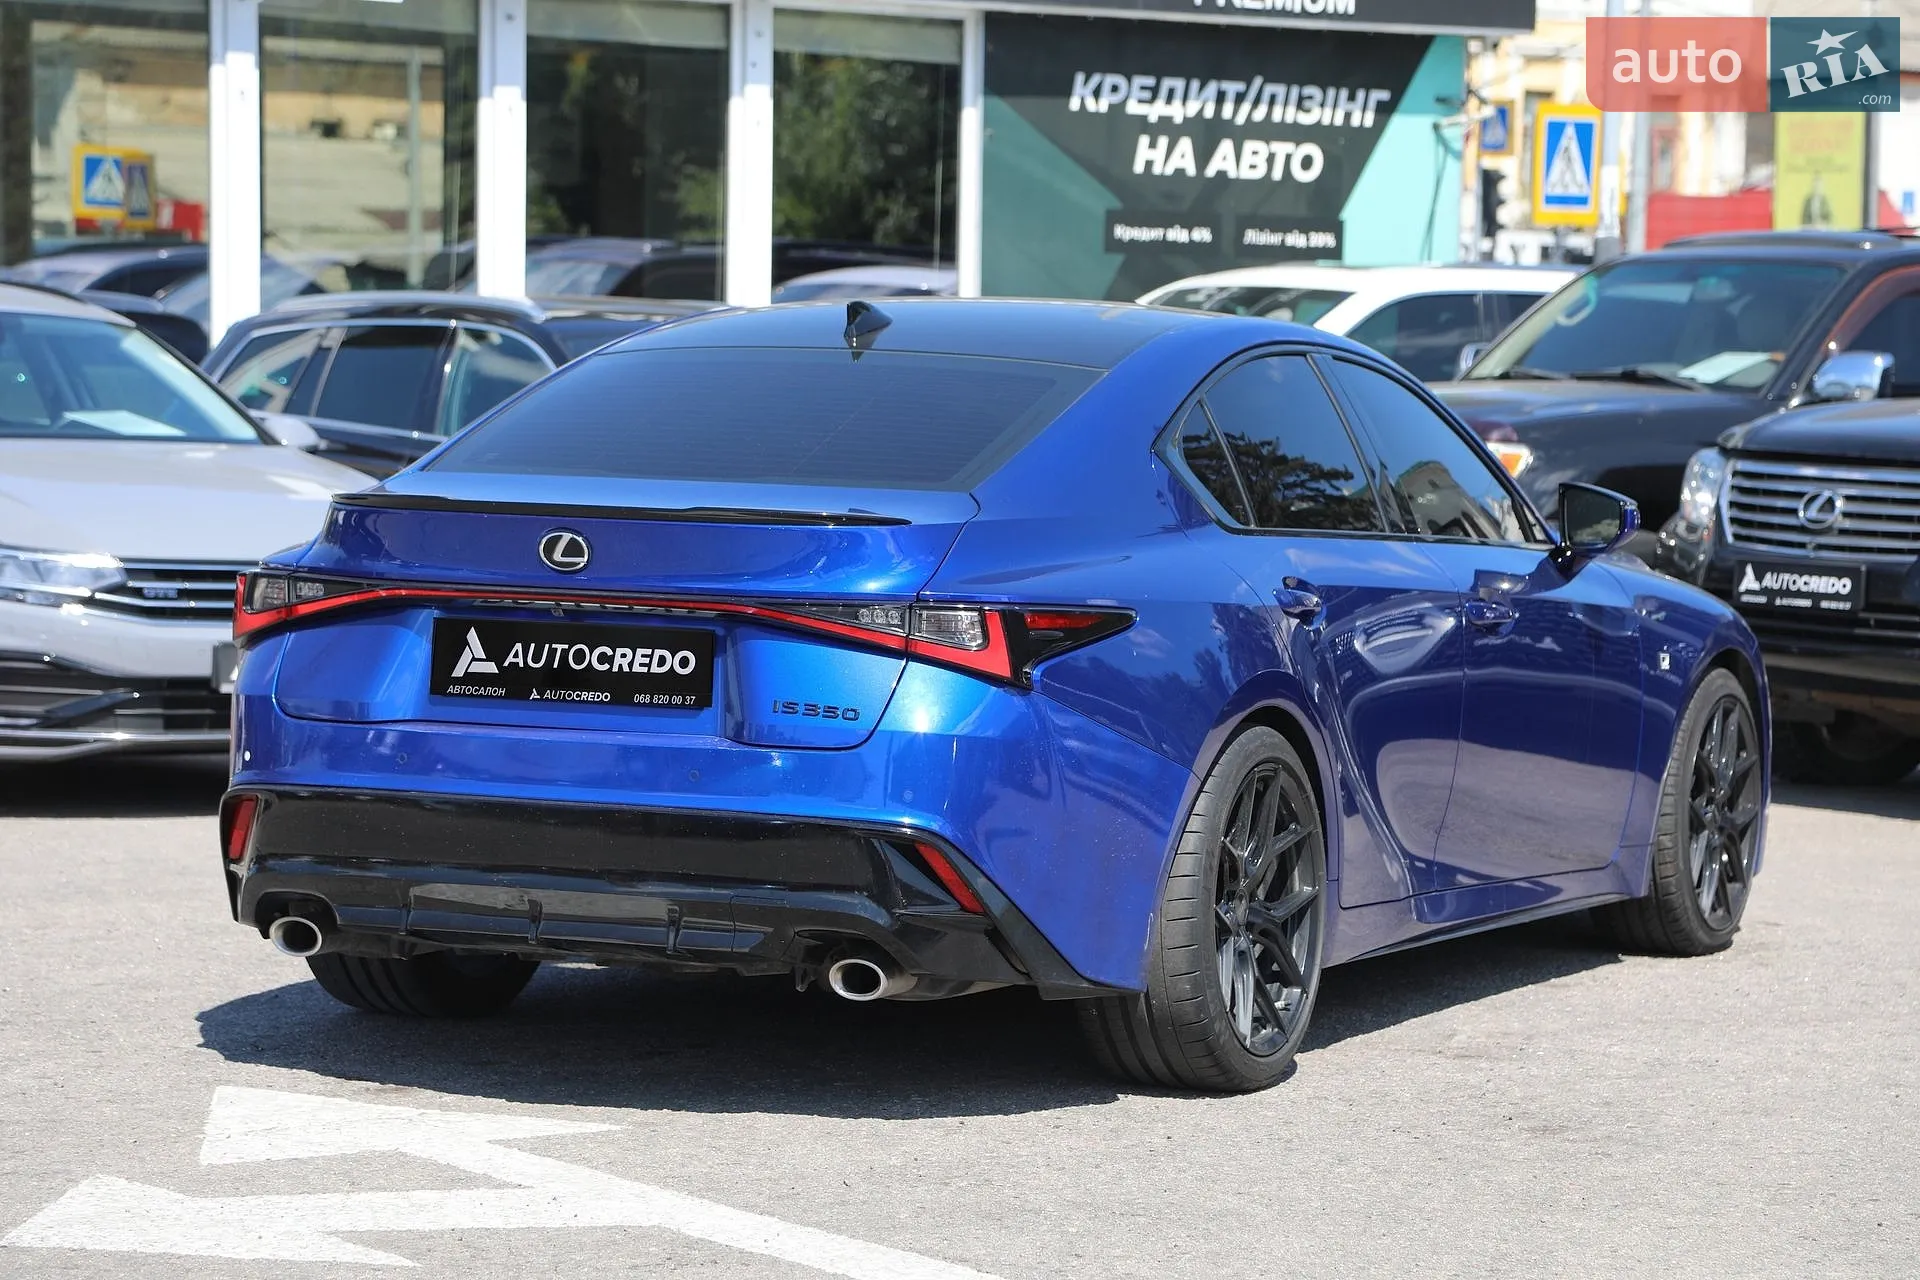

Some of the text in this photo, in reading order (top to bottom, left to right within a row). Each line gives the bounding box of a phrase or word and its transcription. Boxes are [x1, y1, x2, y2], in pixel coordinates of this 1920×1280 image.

[1069, 71, 1391, 128] КРЕДИТ/ЛІЗІНГ
[1133, 134, 1325, 183] НА АВТО
[1761, 571, 1852, 595] AUTOCREDO
[503, 642, 696, 675] AUTOCREDO
[446, 684, 506, 697] АВТОСАЛОН
[543, 689, 611, 702] AUTOCREDO
[633, 694, 696, 705] 068 820 00 37
